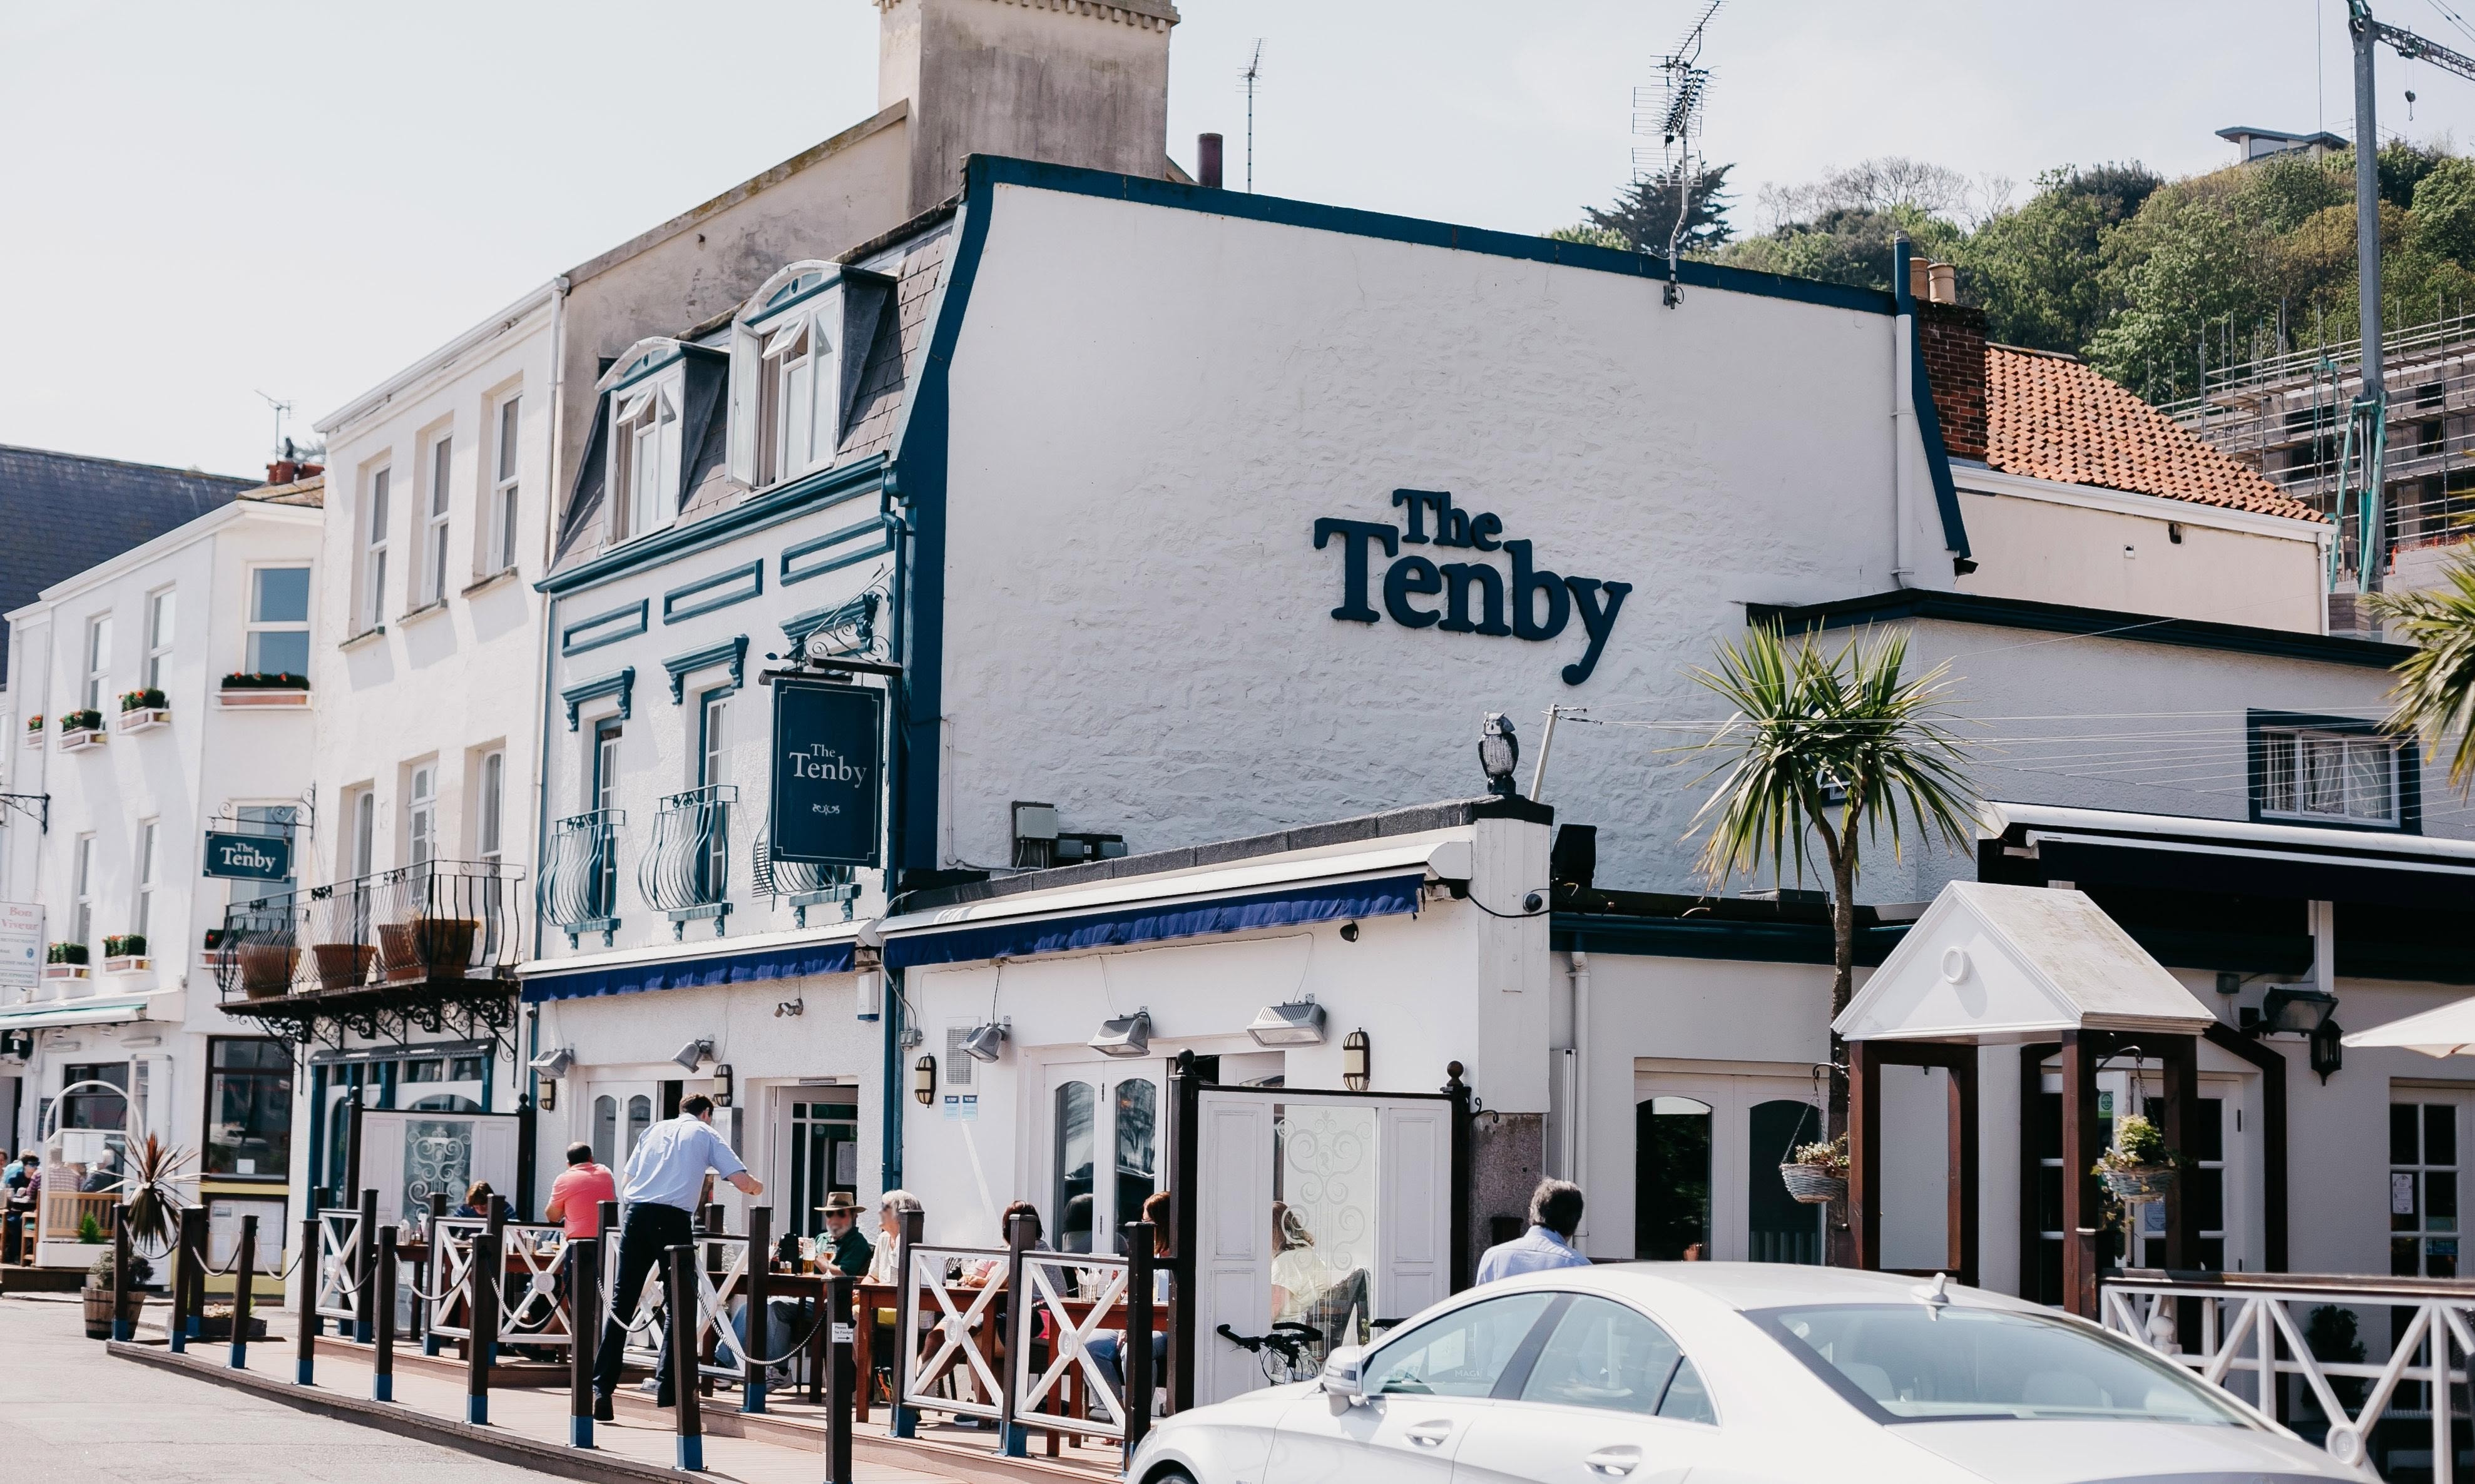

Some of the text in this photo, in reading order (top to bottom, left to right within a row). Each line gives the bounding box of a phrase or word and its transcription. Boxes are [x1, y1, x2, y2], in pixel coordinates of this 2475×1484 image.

[1392, 488, 1503, 552] The
[1314, 517, 1633, 686] Tenby
[810, 743, 836, 758] The
[788, 752, 868, 788] Tenby
[235, 842, 254, 853] The
[220, 846, 277, 873] Tenby
[9, 906, 33, 917] Bon
[1, 918, 39, 931] Viveur
